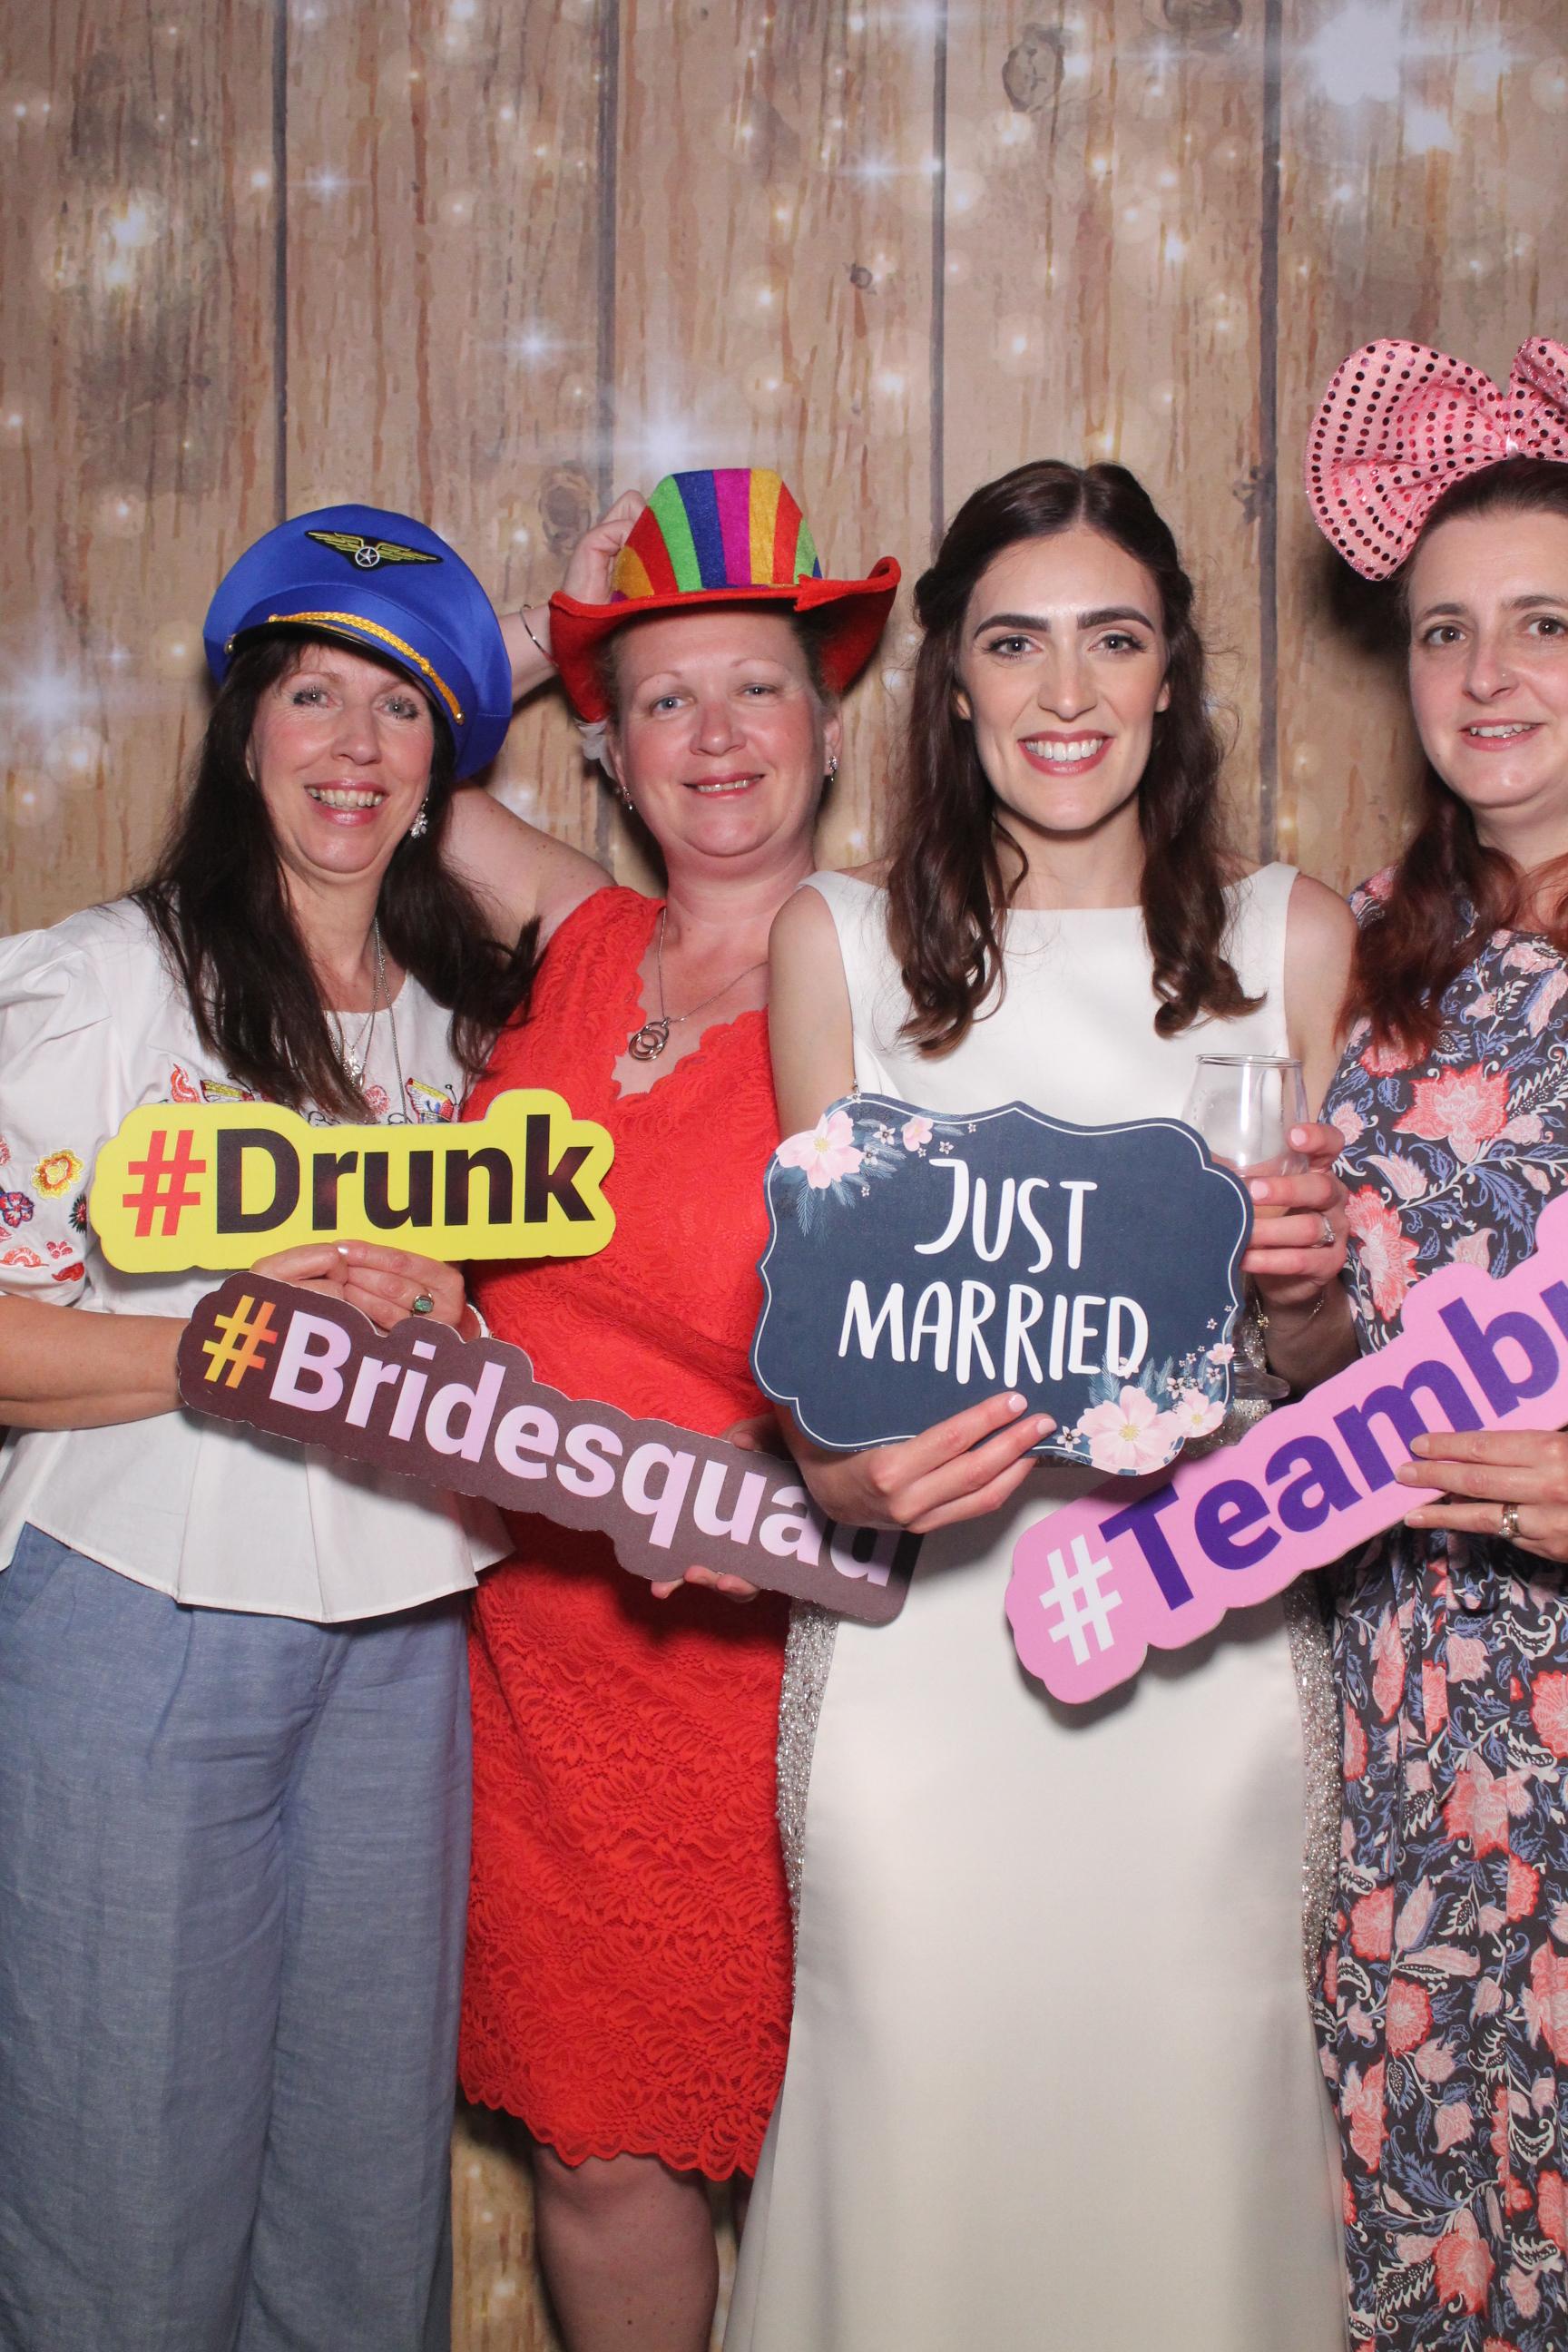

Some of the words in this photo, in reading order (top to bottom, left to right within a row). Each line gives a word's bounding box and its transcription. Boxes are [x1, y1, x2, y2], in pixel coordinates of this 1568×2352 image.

[122, 1113, 596, 1237] #Drunk
[915, 1158, 1097, 1273] JUST
[838, 1279, 1149, 1387] MARRIED
